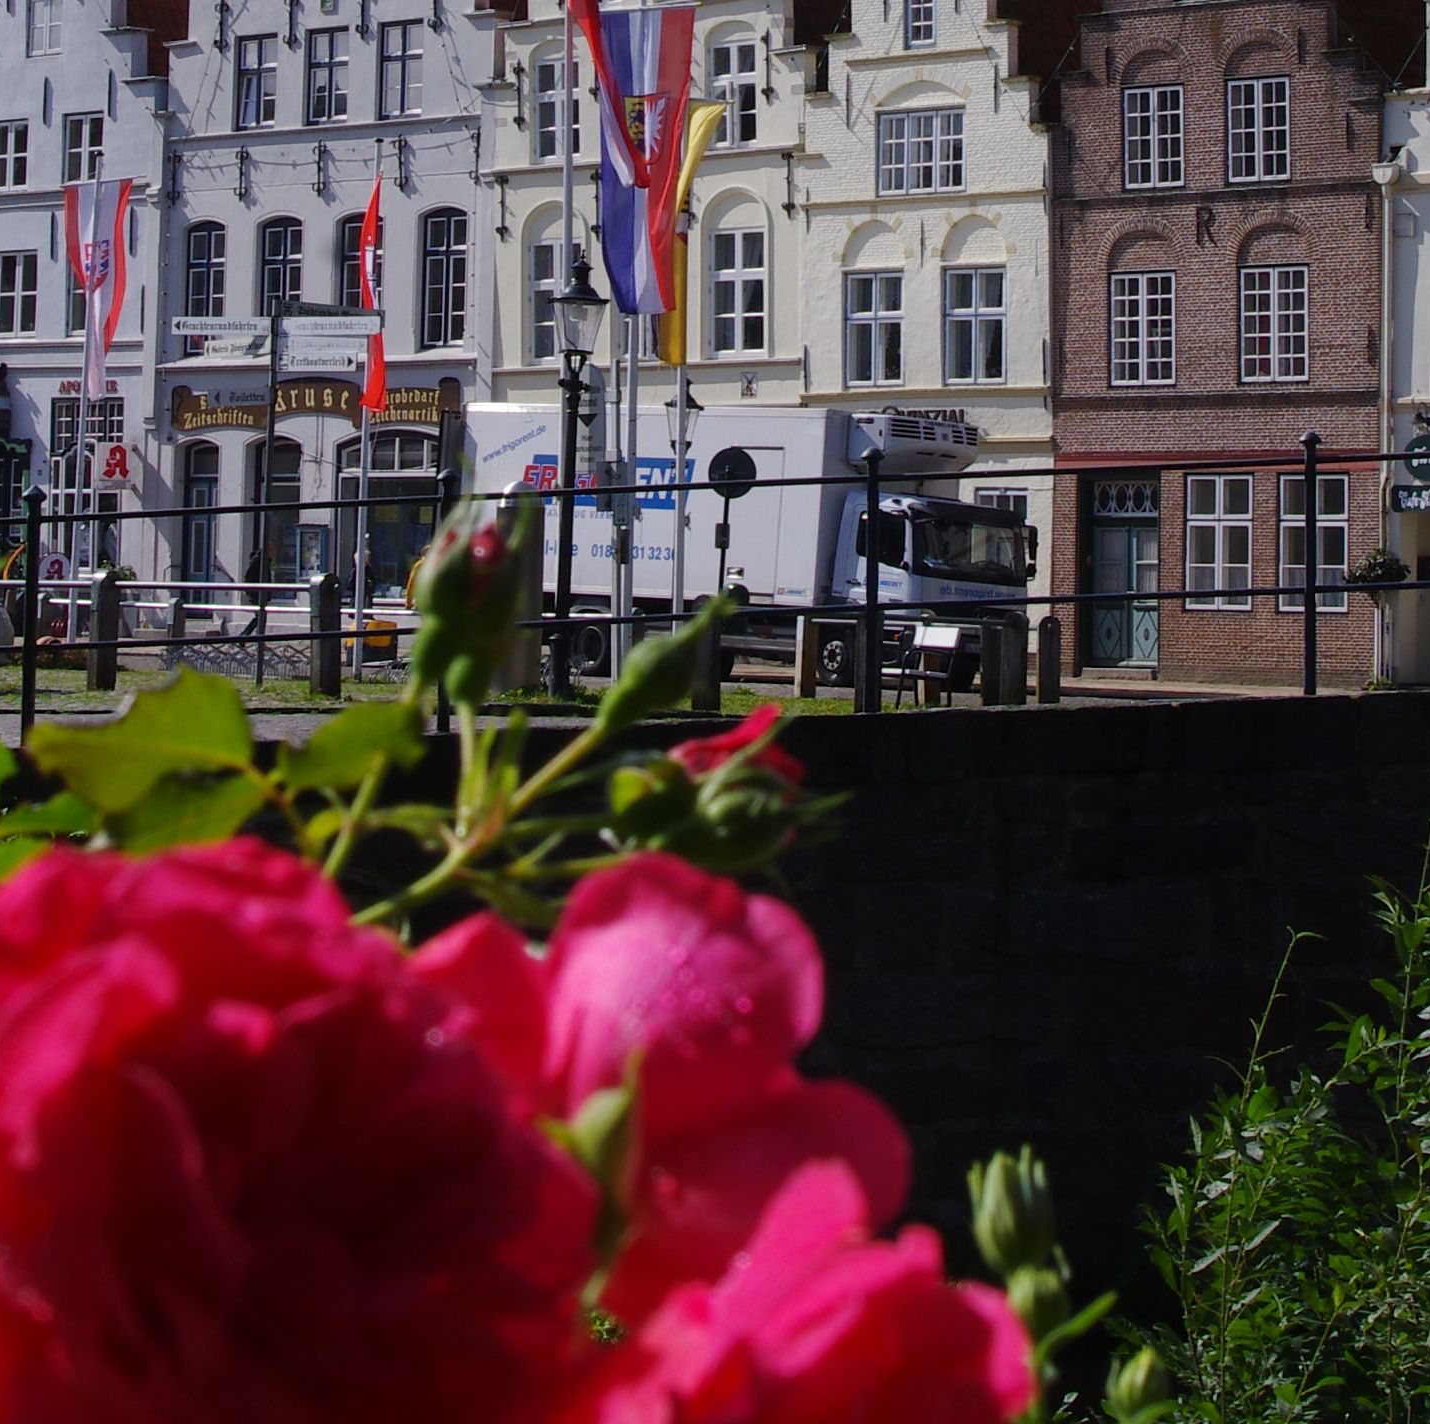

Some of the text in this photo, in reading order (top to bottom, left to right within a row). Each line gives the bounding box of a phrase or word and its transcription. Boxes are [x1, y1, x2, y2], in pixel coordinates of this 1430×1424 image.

[229, 391, 266, 403] Toiletten
[183, 407, 254, 429] Zeitschriften
[482, 425, 546, 463] www.frigorent.de
[102, 444, 130, 479] A
